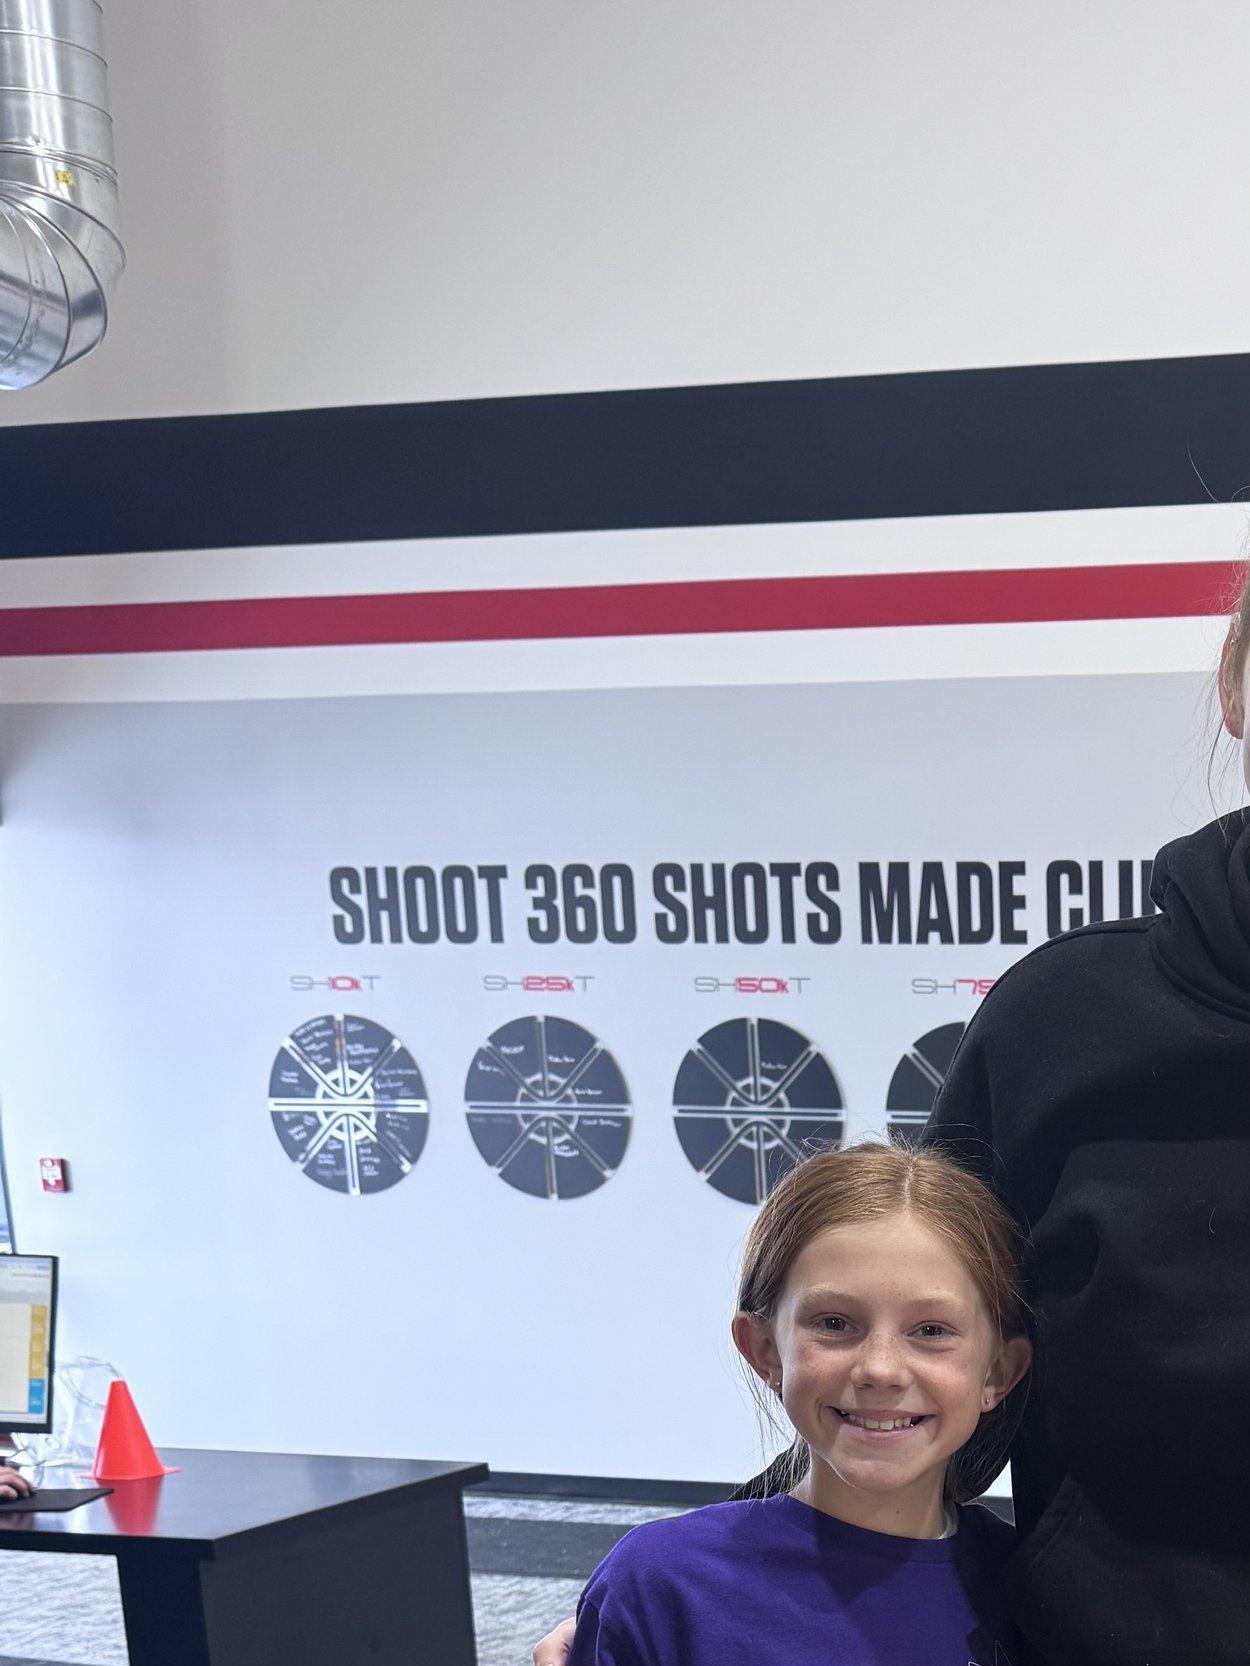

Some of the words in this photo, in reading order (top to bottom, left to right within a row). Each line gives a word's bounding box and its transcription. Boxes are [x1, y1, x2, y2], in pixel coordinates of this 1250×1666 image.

[330, 864, 508, 945] SHOOT
[524, 862, 637, 945] 360
[653, 860, 841, 945] SHOTS
[859, 860, 1028, 945] MADE
[1046, 860, 1156, 941] CLU
